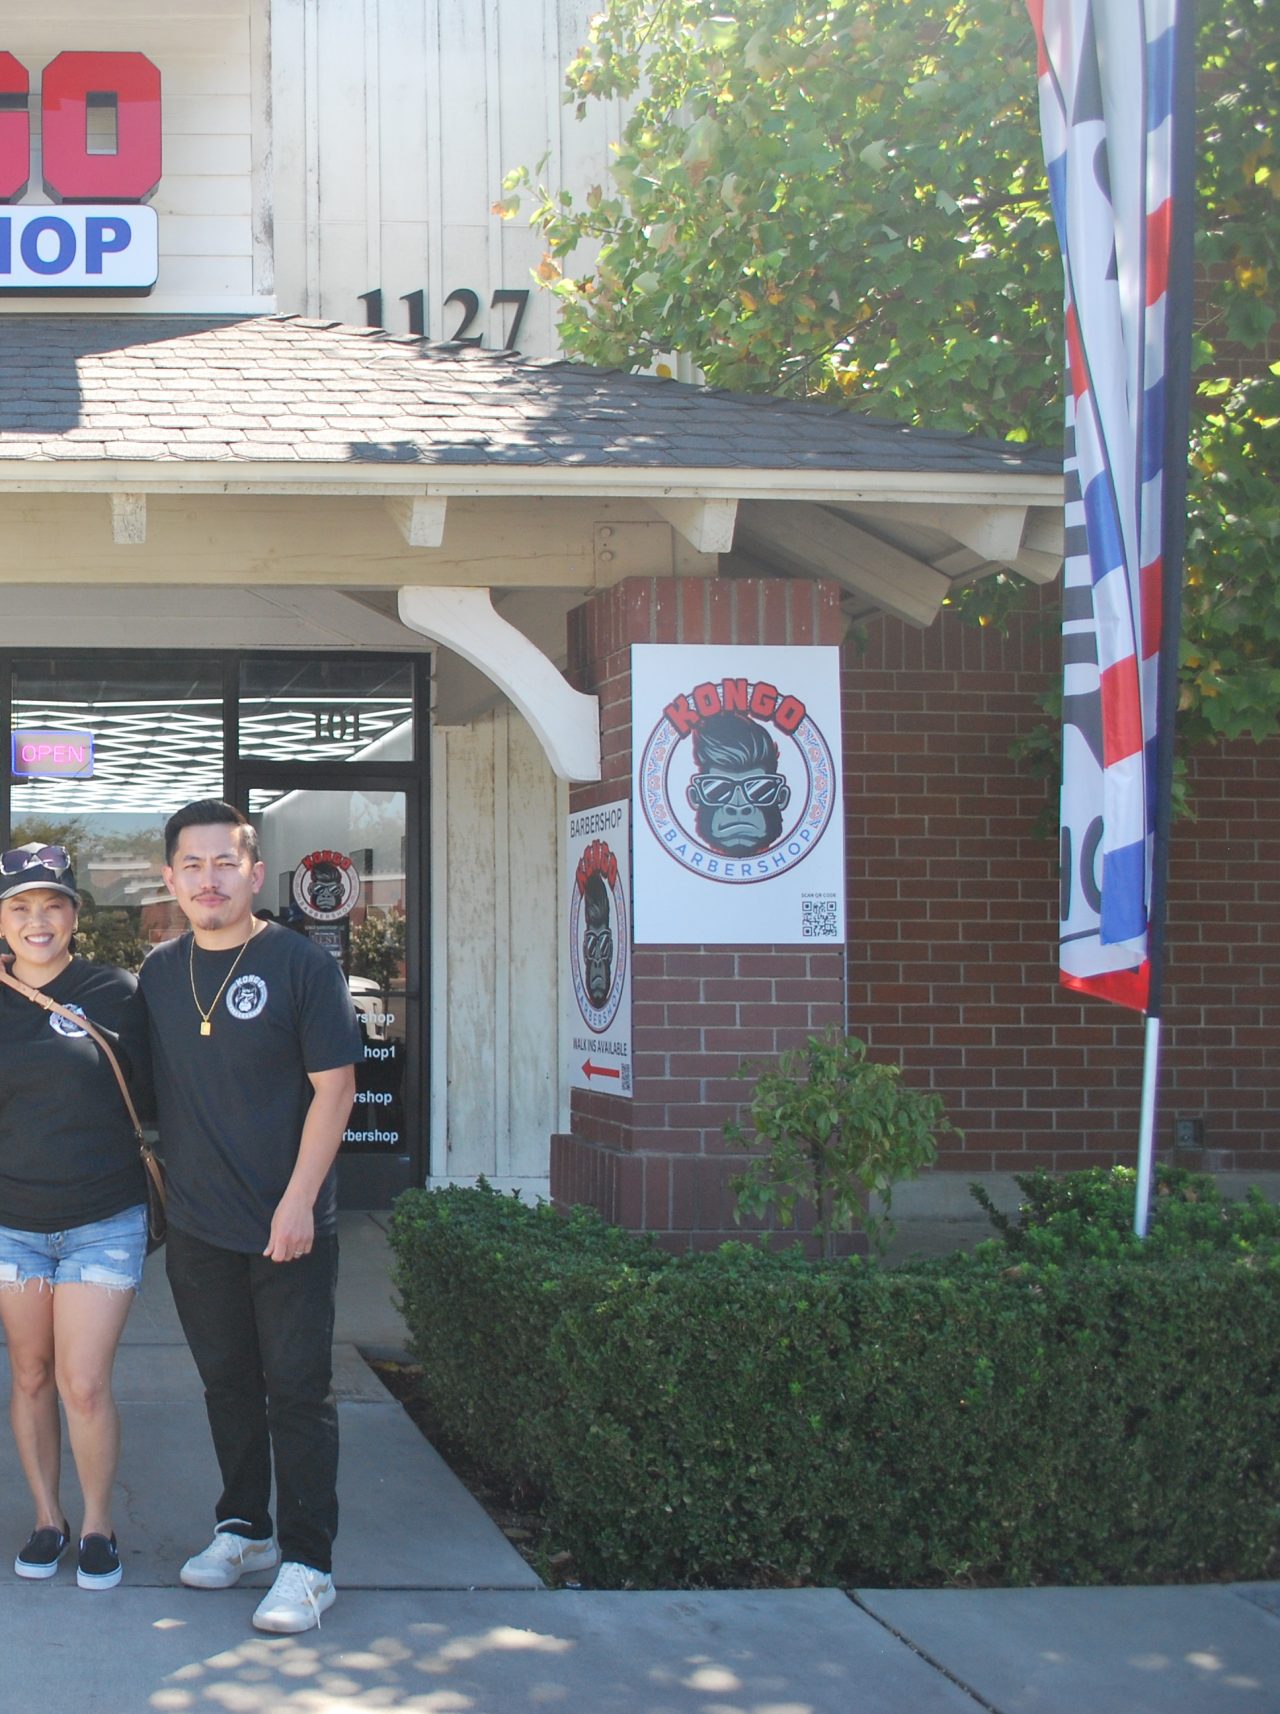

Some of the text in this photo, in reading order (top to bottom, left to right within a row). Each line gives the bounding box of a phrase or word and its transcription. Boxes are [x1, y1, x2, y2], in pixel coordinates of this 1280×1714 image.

[356, 288, 530, 350] 1127
[664, 677, 807, 739] KONGO
[313, 711, 361, 741] 101
[21, 744, 86, 764] OPEN
[570, 808, 622, 838] BARBERSHOP
[302, 850, 352, 871] KONGO
[663, 829, 812, 876] BARBERSHOP
[576, 839, 618, 895] KONGO
[236, 974, 266, 988] KONGO
[356, 1013, 395, 1026] rshop
[363, 1045, 395, 1061] hop1
[573, 1037, 627, 1057] WALK INS AVAILABLE
[353, 1090, 393, 1106] rshop
[342, 1129, 399, 1144] rbershop
